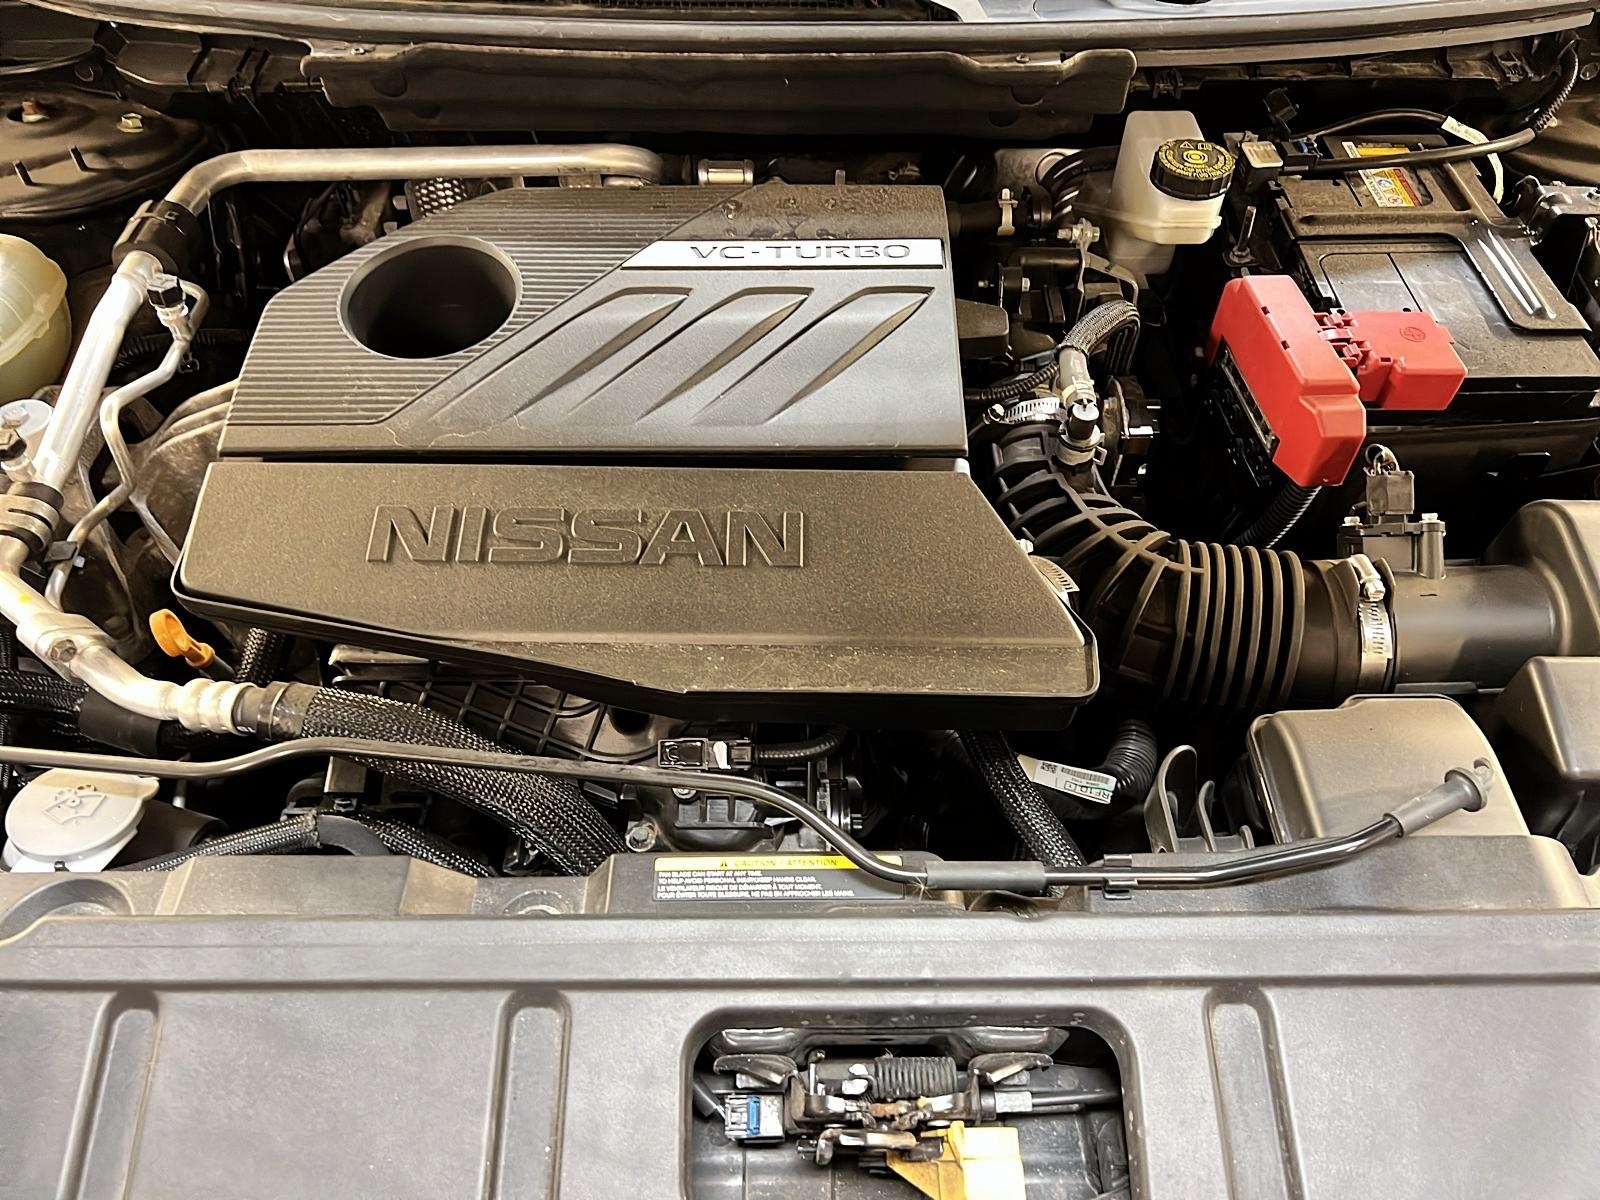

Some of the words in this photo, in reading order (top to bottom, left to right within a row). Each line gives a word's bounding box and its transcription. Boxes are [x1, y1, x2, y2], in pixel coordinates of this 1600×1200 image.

[690, 244, 911, 259] VC-TURBO
[365, 504, 804, 567] NISSAN
[787, 859, 838, 867] ATTENTION
